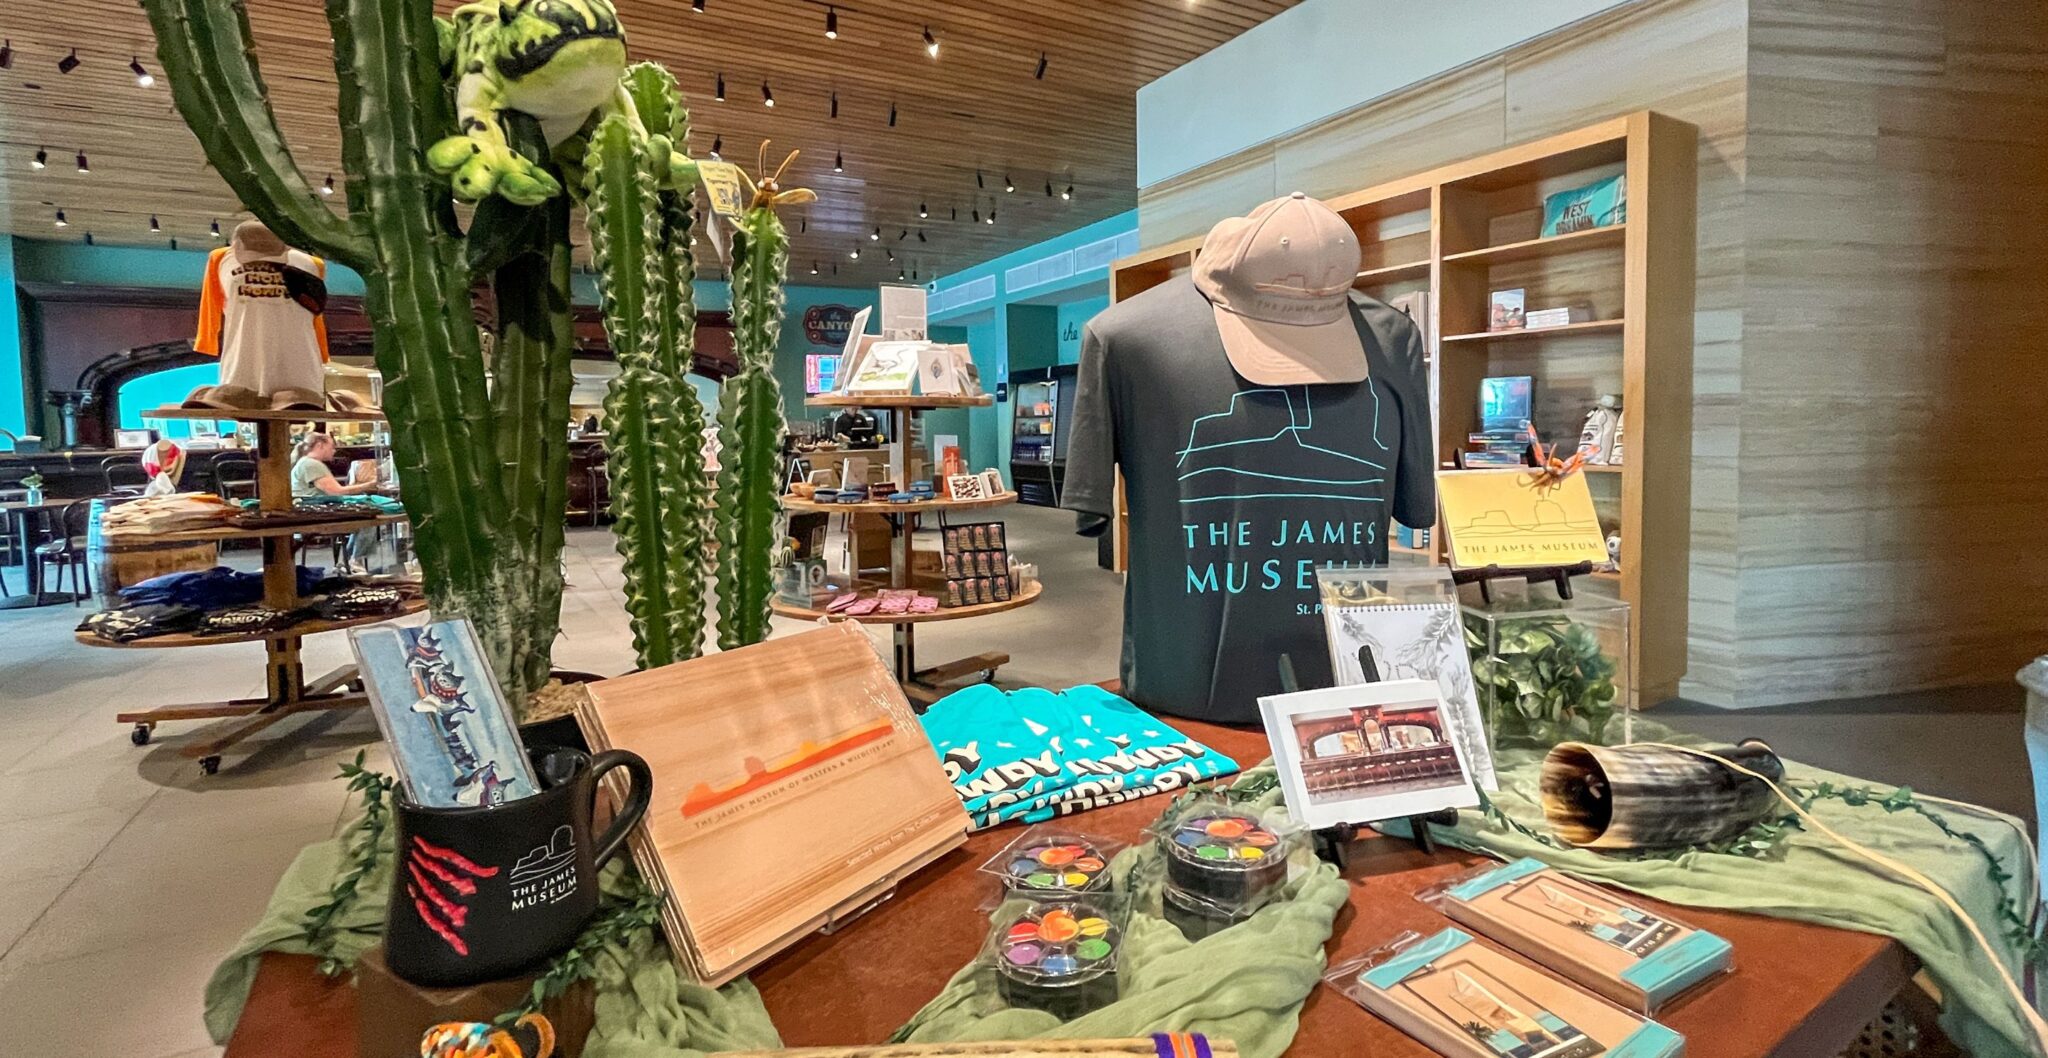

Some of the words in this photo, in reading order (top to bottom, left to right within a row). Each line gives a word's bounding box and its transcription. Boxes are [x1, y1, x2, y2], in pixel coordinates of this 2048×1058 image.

[808, 320, 852, 330] CANYO
[1183, 521, 1251, 549] THE
[1271, 519, 1376, 547] JAMES
[1464, 545, 1487, 553] THE
[1495, 543, 1535, 553] JAMES
[1542, 542, 1598, 551] MUSEUM
[1296, 603, 1311, 615] St.
[694, 817, 714, 829] THE
[714, 803, 746, 825] JAMES
[749, 786, 785, 806] MUSEUM
[788, 779, 801, 790] OF
[802, 763, 838, 782] WESTERN
[511, 875, 577, 911] MUSEUM
[512, 883, 537, 898] THE
[541, 864, 576, 890] JAMES
